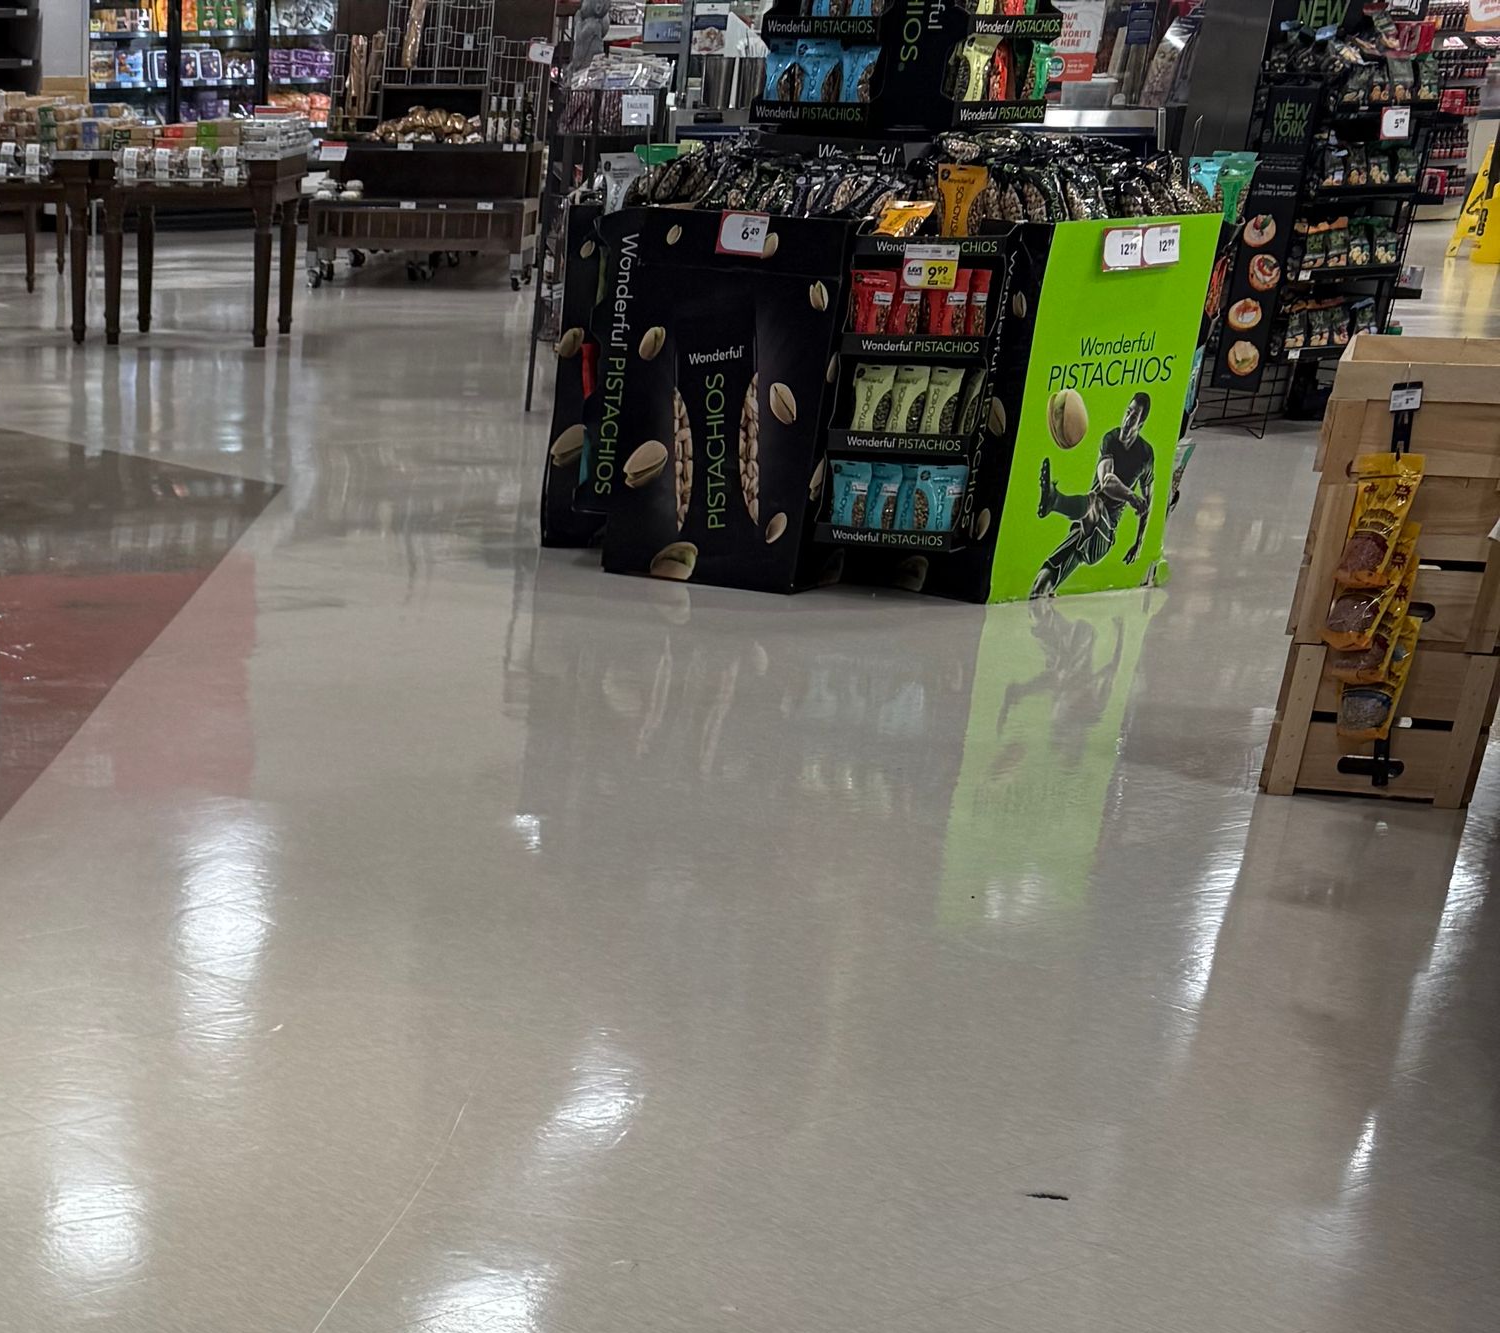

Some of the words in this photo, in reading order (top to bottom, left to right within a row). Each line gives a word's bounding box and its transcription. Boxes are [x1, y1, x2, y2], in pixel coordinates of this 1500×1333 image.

[767, 17, 812, 33] Wonderful
[975, 16, 1014, 34] Wonderful
[755, 104, 801, 119] Wonderful
[960, 105, 998, 122] Wonderful
[1273, 96, 1312, 120] NEW
[1272, 120, 1308, 138] YORK
[610, 233, 640, 351] Wonderful
[861, 339, 913, 352] Wonderful
[914, 341, 980, 353] PISTACHIOS
[1080, 331, 1156, 357] Wonderful
[688, 345, 744, 366] Wonderful
[1048, 355, 1175, 392] PISTACHIOS
[595, 357, 626, 496] PISTACHIOS
[705, 373, 726, 530] PISTACHIOS
[847, 435, 896, 449] Wonderful
[898, 438, 961, 452] PISTACHIOS
[832, 529, 880, 542] Wonderful
[881, 532, 943, 547] PISTACHIOS
